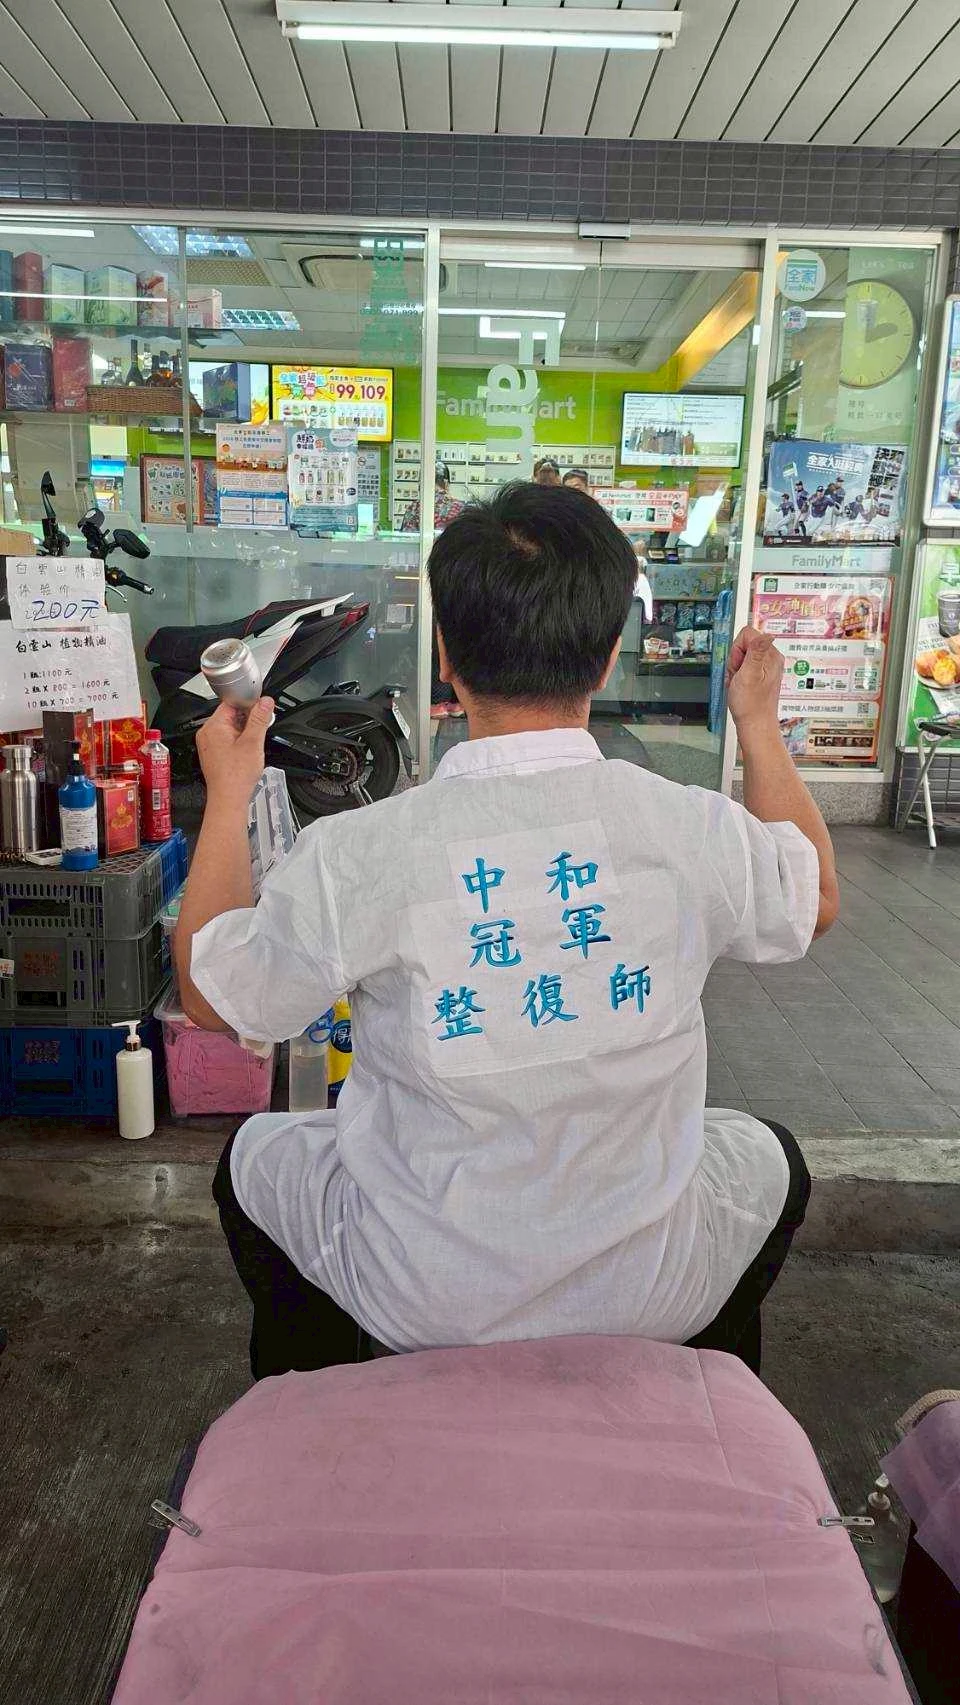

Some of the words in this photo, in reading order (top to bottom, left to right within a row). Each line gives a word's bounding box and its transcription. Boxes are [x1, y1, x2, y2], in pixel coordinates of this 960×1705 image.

[336, 384, 356, 399] 99
[361, 384, 386, 400] 109
[436, 390, 577, 420] Famart
[792, 554, 862, 569] FamilyMart
[430, 963, 652, 1042] 整復師
